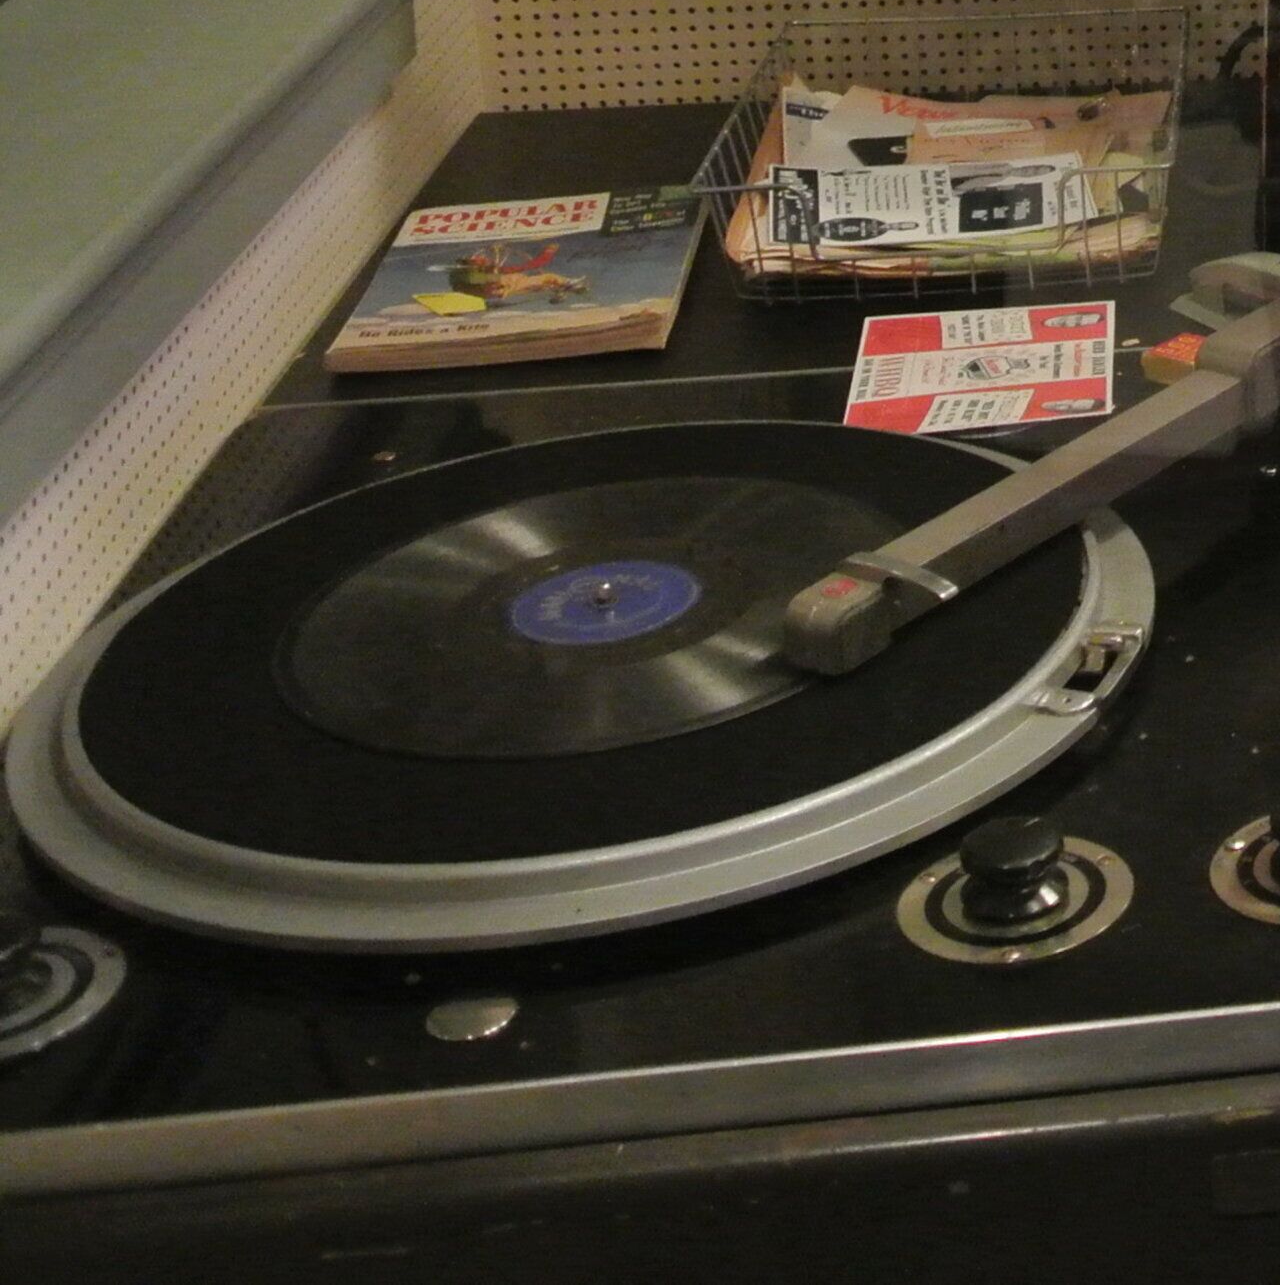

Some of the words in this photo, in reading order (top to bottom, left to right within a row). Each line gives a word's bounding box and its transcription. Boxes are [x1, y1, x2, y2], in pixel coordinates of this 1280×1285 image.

[418, 198, 600, 225] POPULAR
[410, 212, 596, 236] SCIENCE
[387, 327, 433, 338] Rides
[457, 323, 491, 333] Kite
